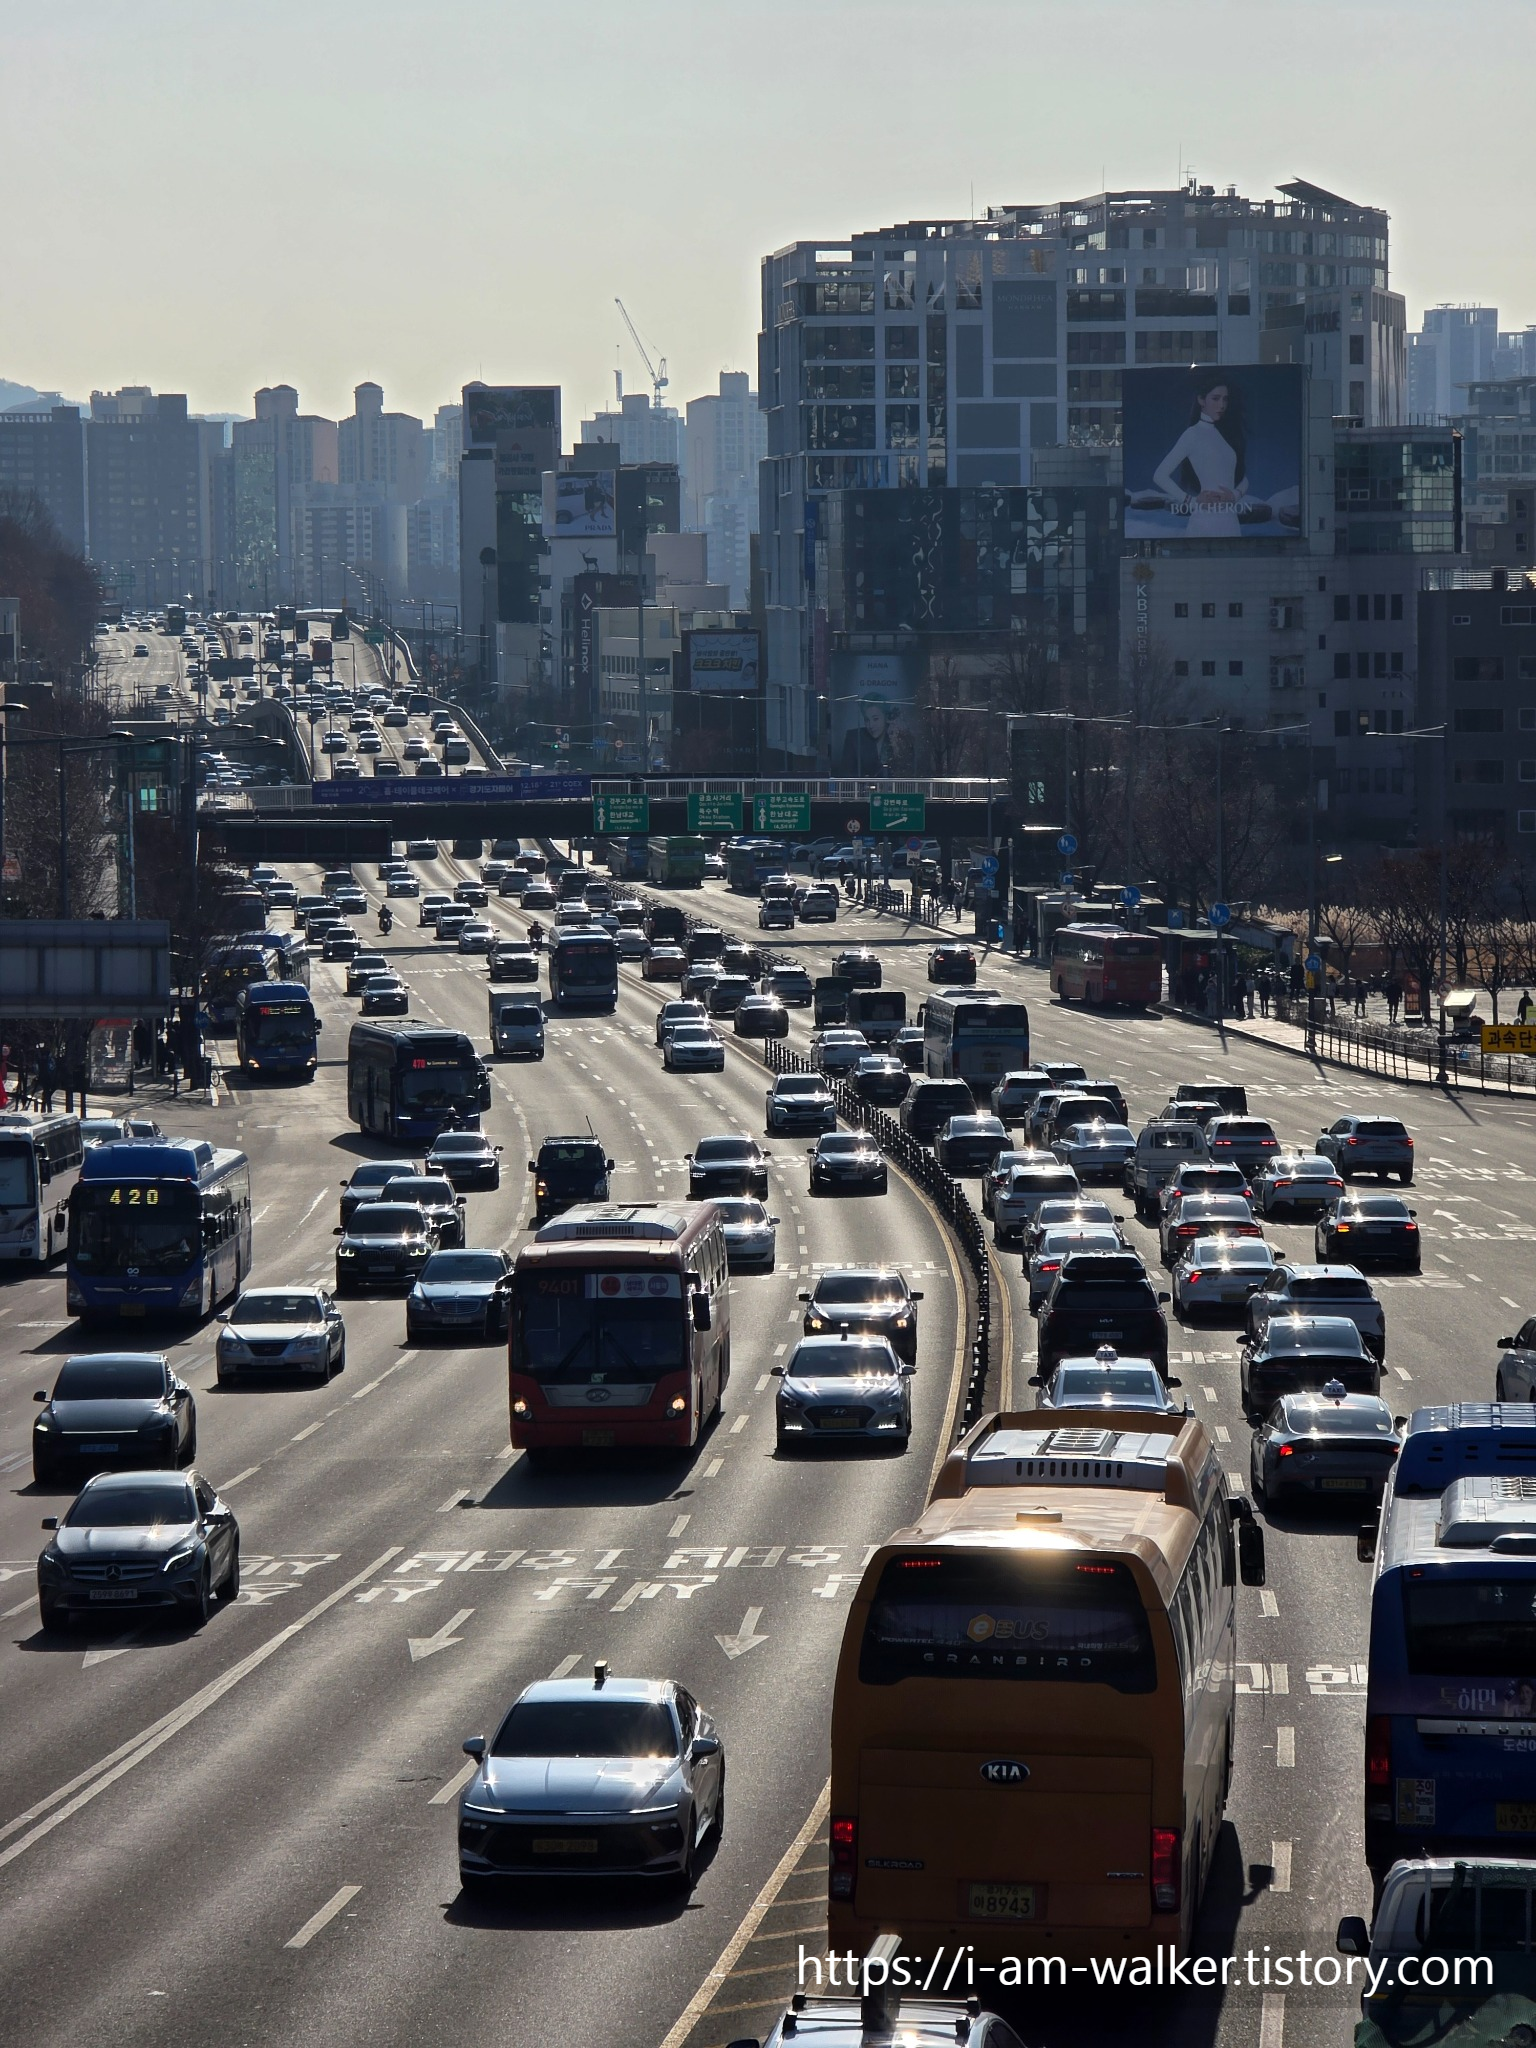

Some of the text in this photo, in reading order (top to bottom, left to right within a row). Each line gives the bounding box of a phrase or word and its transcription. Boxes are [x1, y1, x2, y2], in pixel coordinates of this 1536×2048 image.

[1170, 503, 1253, 514] BOUCHERON
[581, 619, 591, 673] Helinox
[562, 780, 583, 788] COEX
[698, 794, 732, 802] 금호사거리
[609, 811, 635, 819] 한남대교
[769, 810, 799, 818] 한남대교
[1488, 1029, 1536, 1049] 과속단
[109, 1188, 160, 1205] 420
[537, 1279, 578, 1297] 9401
[881, 1637, 935, 1645] POWERTEC
[923, 1653, 1092, 1667] GRANBIRD
[987, 1765, 1021, 1780] KIA
[1415, 1780, 1434, 1796] 주의
[868, 1859, 922, 1870] SILKROAD
